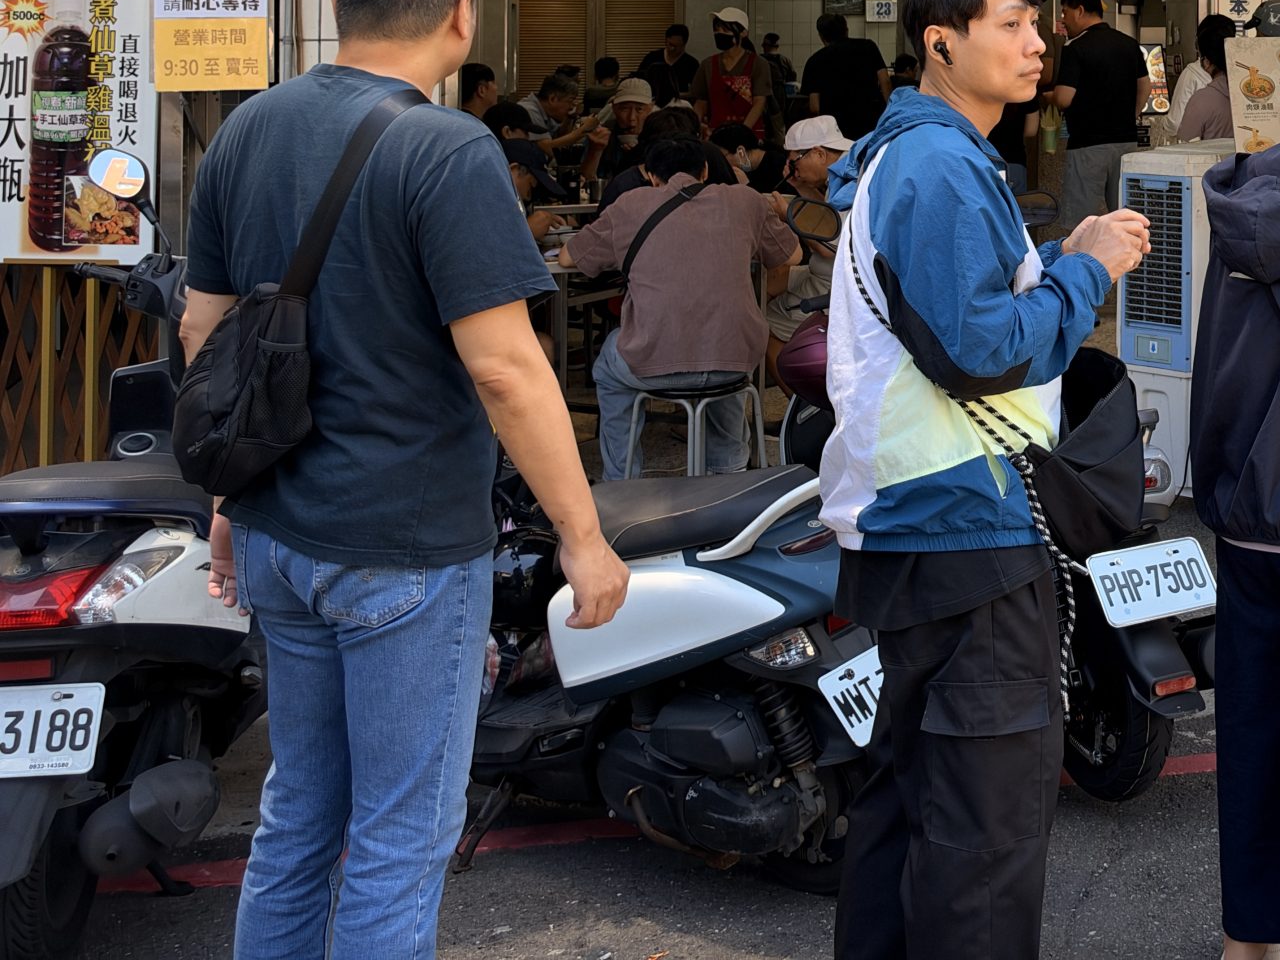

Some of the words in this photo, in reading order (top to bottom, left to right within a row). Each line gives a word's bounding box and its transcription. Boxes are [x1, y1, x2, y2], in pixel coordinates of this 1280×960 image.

[6, 10, 45, 22] 1500cc
[876, 2, 892, 16] 23
[173, 28, 247, 46] 營業時間
[164, 59, 199, 76] 9:30
[204, 57, 221, 76] 至
[225, 57, 259, 76] 賣完
[116, 33, 141, 146] 直接喝退火
[0, 52, 28, 203] 加大瓶
